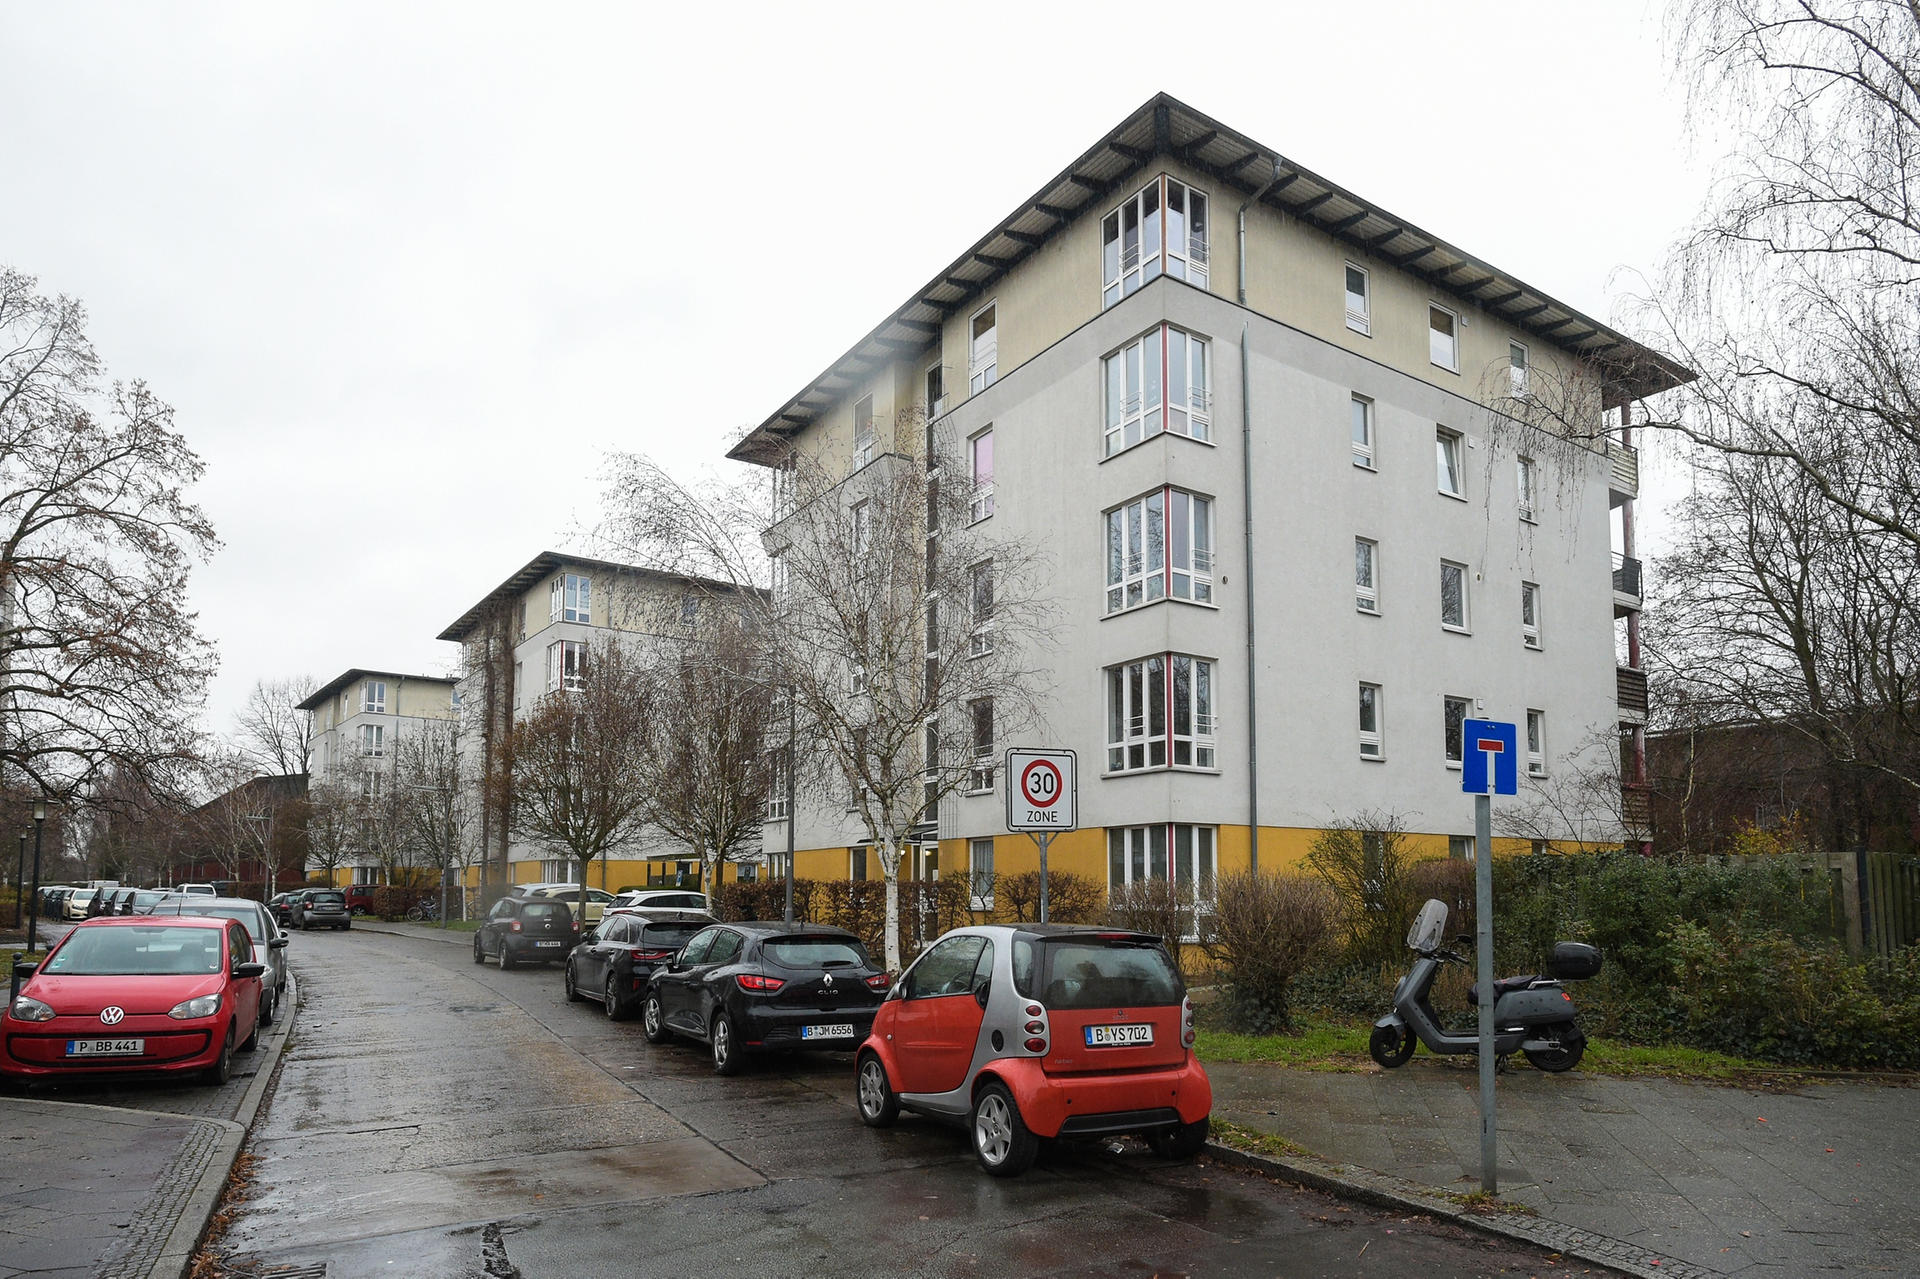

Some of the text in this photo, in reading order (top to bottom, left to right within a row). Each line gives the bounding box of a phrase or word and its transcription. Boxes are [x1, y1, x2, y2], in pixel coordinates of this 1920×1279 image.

[1030, 772, 1054, 794] 30
[1026, 810, 1058, 823] ZONE
[1096, 1028, 1104, 1042] B
[79, 1041, 88, 1052] P
